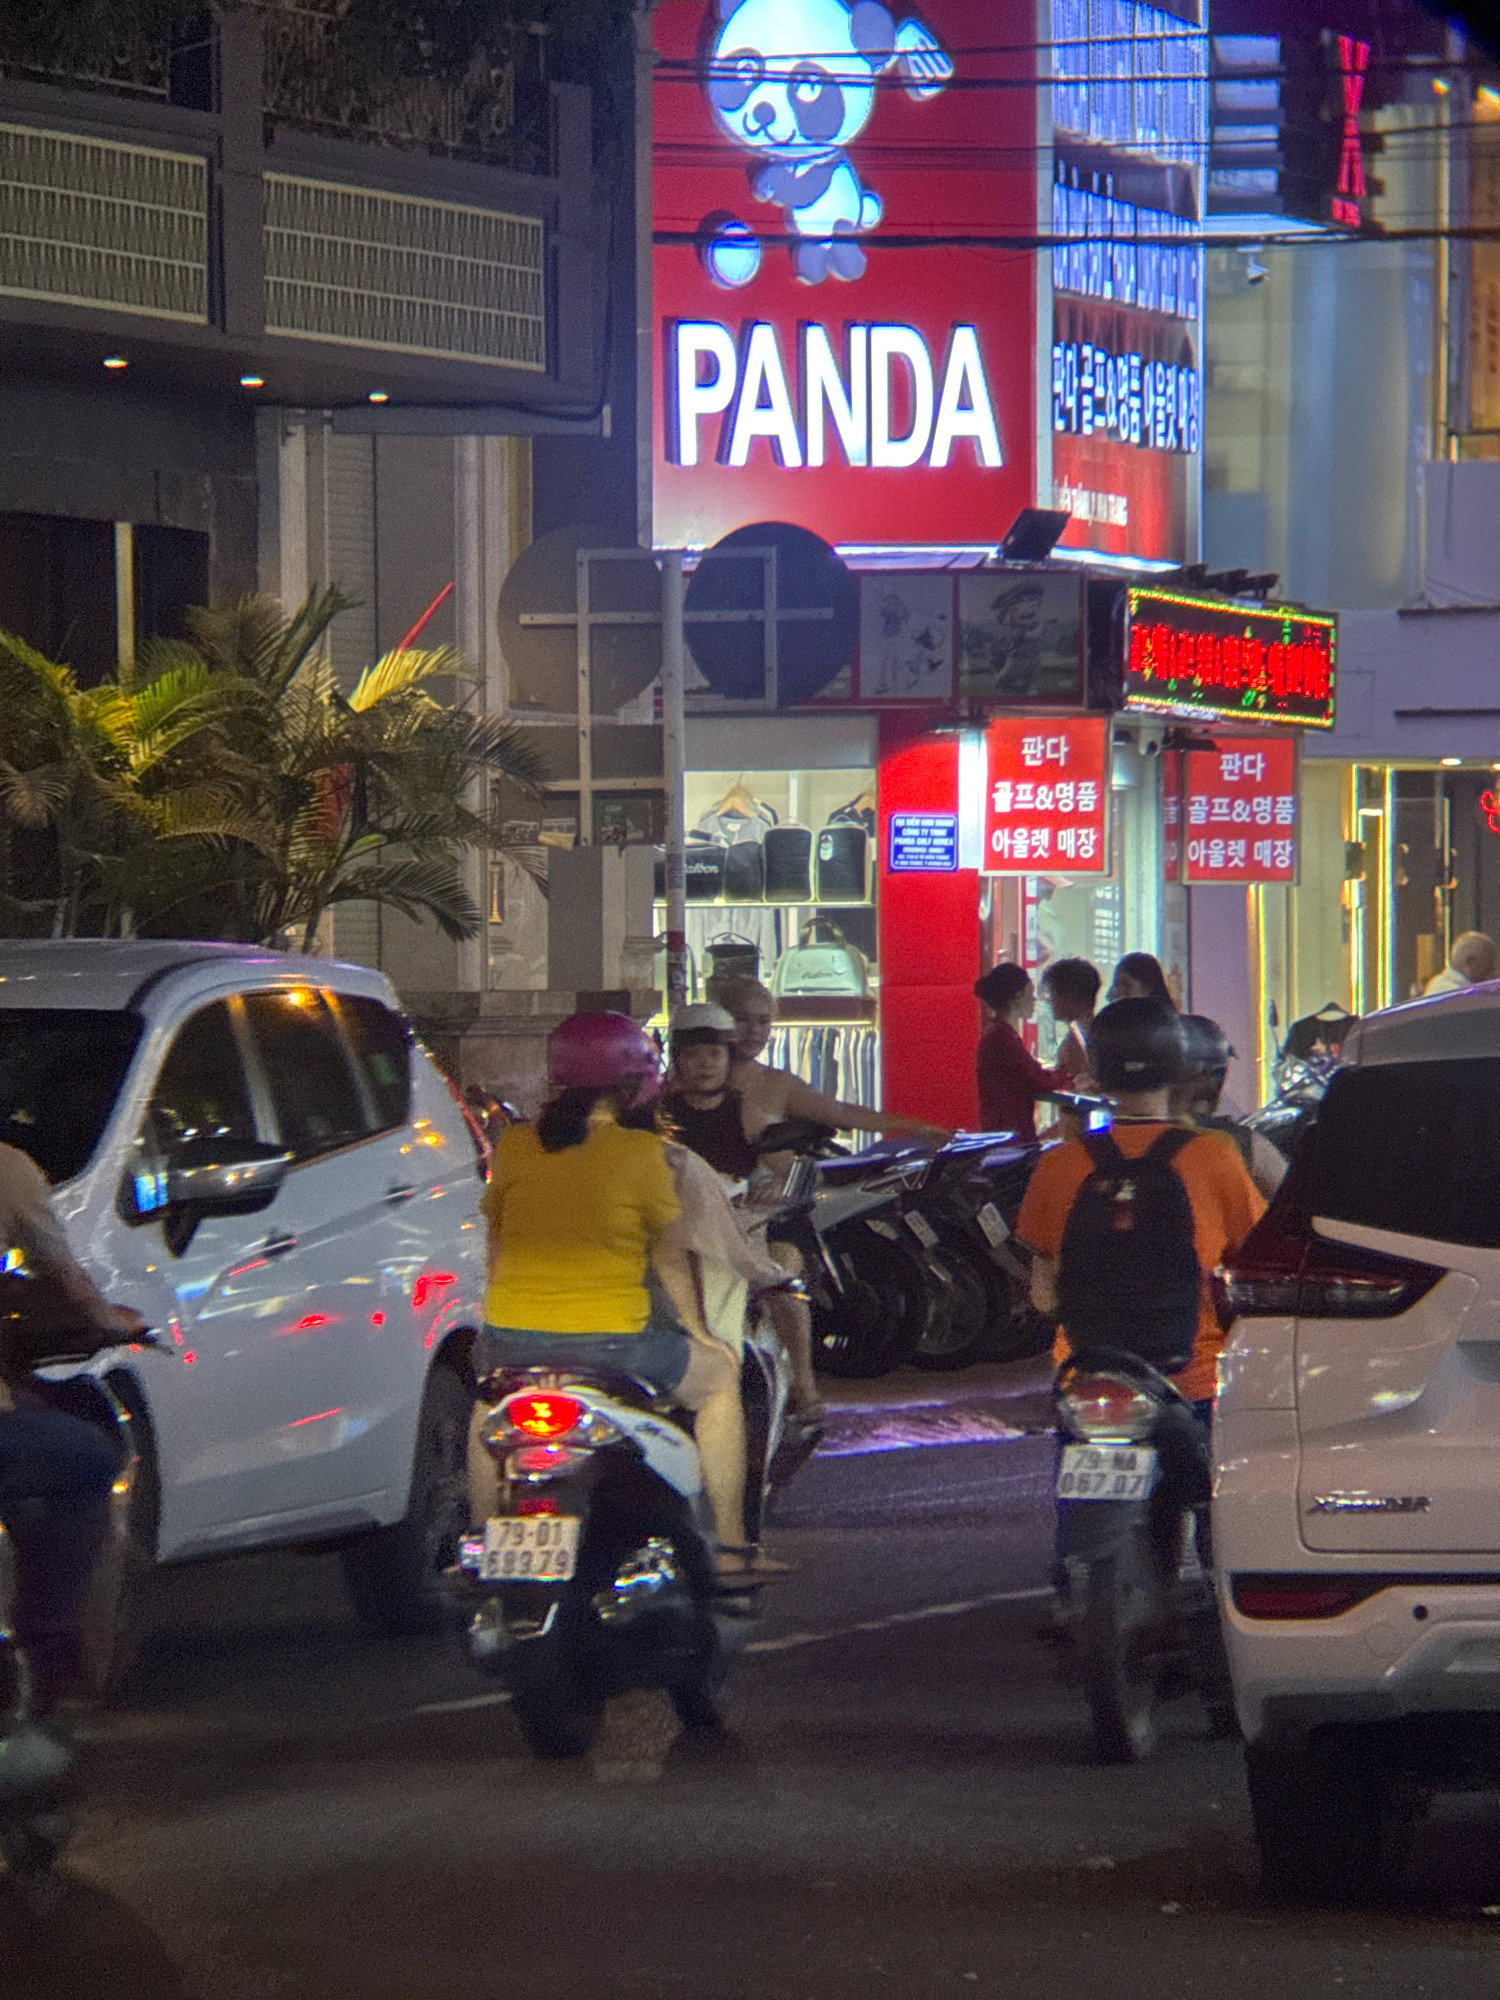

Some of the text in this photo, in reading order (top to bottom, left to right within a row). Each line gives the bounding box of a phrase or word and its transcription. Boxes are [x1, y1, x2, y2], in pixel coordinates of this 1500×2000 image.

[670, 319, 1004, 467] PANDA
[1021, 735, 1069, 767] 판다
[1220, 753, 1266, 782] 판다
[992, 781, 1098, 813] 골프&명품
[1188, 795, 1296, 825] 골프&명품
[991, 827, 1098, 859] 아울렛 매장
[1188, 839, 1245, 868] 아울렛
[1253, 840, 1293, 869] 매장
